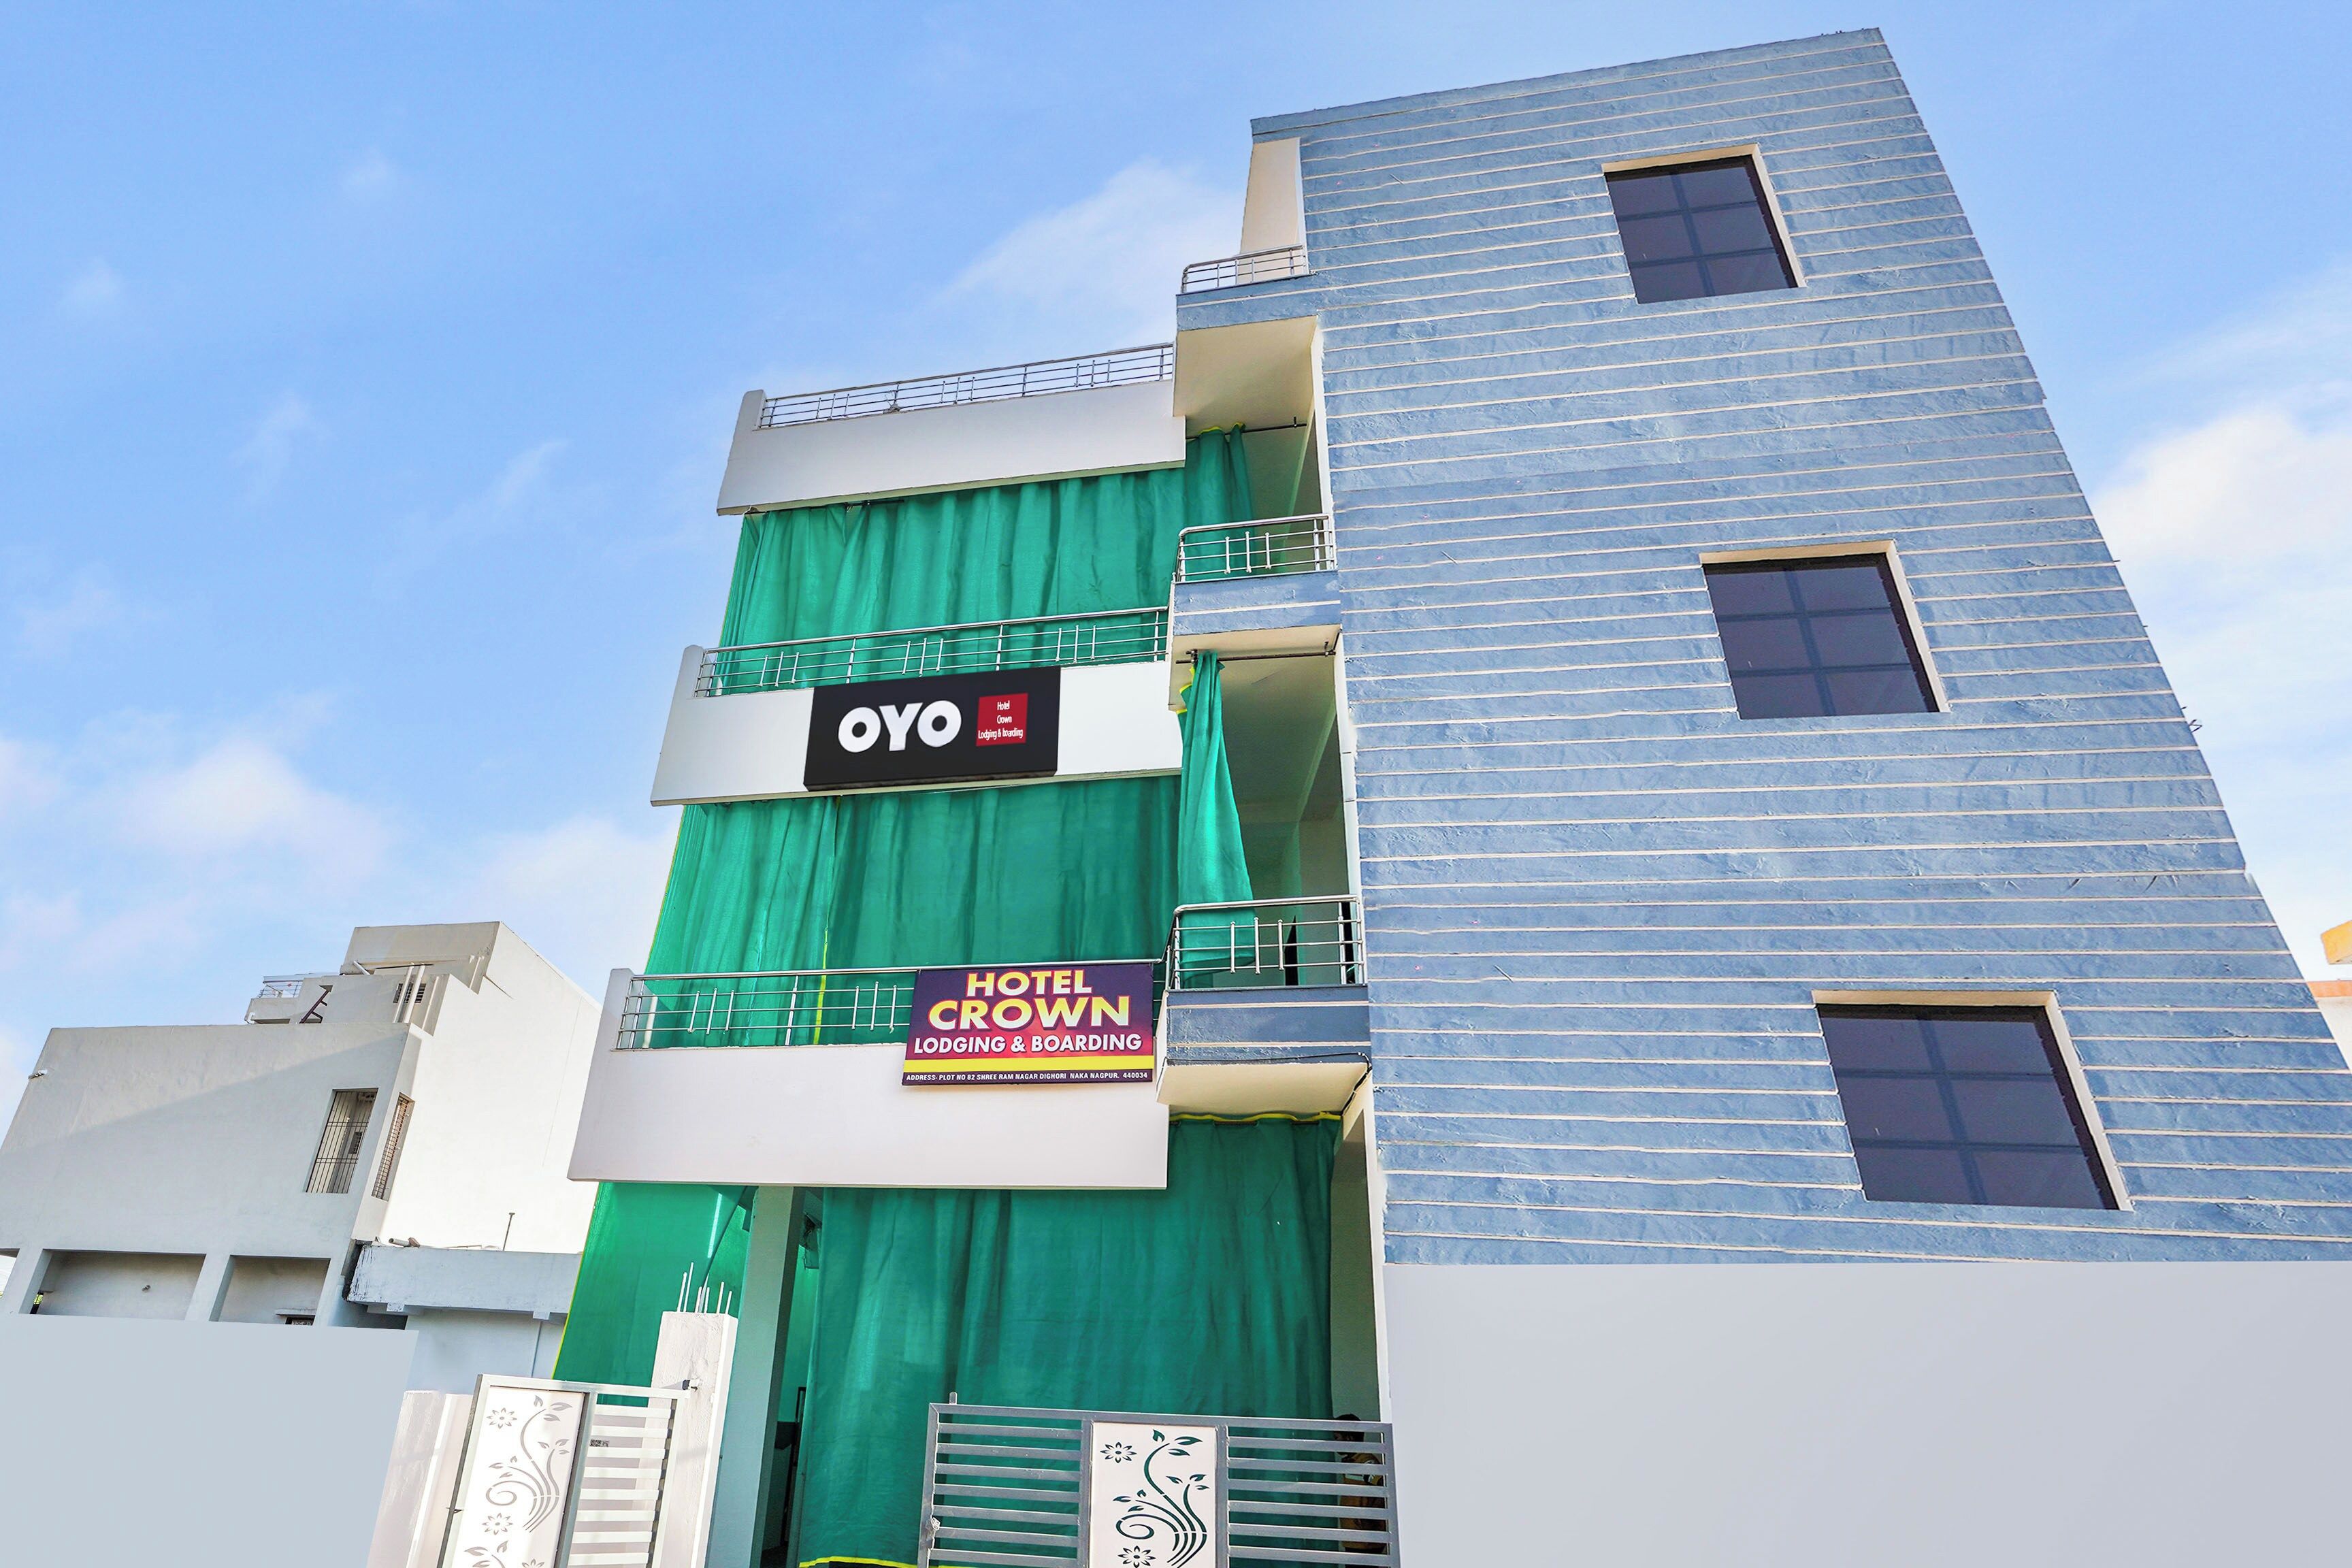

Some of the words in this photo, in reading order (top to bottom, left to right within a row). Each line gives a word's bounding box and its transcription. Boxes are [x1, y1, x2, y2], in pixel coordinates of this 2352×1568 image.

[997, 700, 1010, 710] Hotel
[838, 700, 962, 753] OYO
[997, 715, 1013, 724] Crown
[978, 729, 997, 740] Lodging
[998, 728, 1002, 737] &
[1002, 728, 1024, 738] boarding
[966, 970, 1092, 997] HOTEL
[928, 996, 1130, 1030] CROWN
[914, 1036, 1006, 1054] LODGING
[1011, 1035, 1026, 1052] &
[1031, 1034, 1142, 1052] BOARDING
